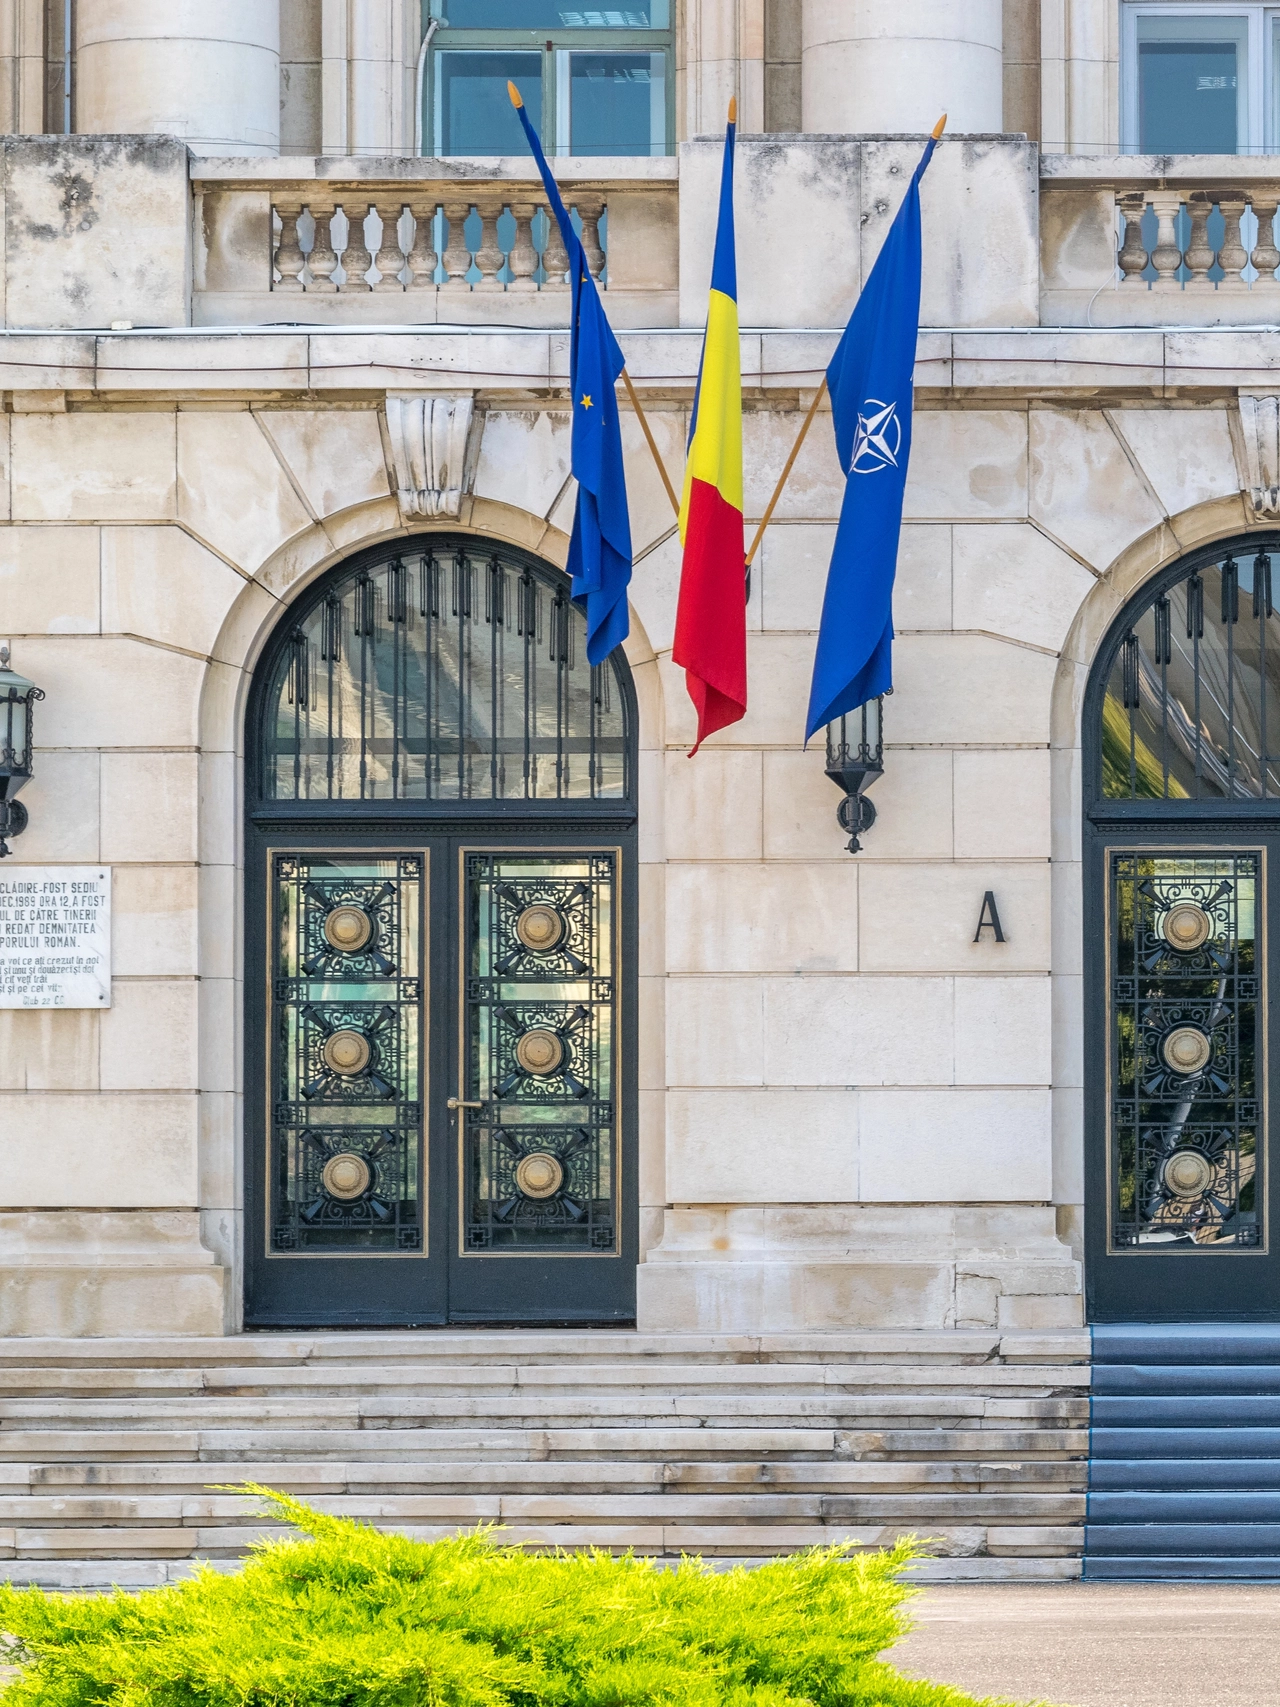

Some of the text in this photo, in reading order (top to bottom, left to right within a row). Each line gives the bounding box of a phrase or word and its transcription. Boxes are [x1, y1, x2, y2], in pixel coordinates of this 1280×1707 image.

[39, 895, 57, 908] ORA
[81, 895, 106, 907] FOST
[14, 909, 26, 921] DE
[63, 909, 97, 921] TINERII
[972, 890, 1007, 943] A
[5, 923, 36, 935] REDAT
[39, 922, 97, 935] DEMNITATEA
[0, 936, 39, 949] PORULUI
[22, 957, 33, 966] ce
[46, 956, 75, 966] crezut
[17, 985, 28, 995] pe
[30, 984, 45, 993] cei
